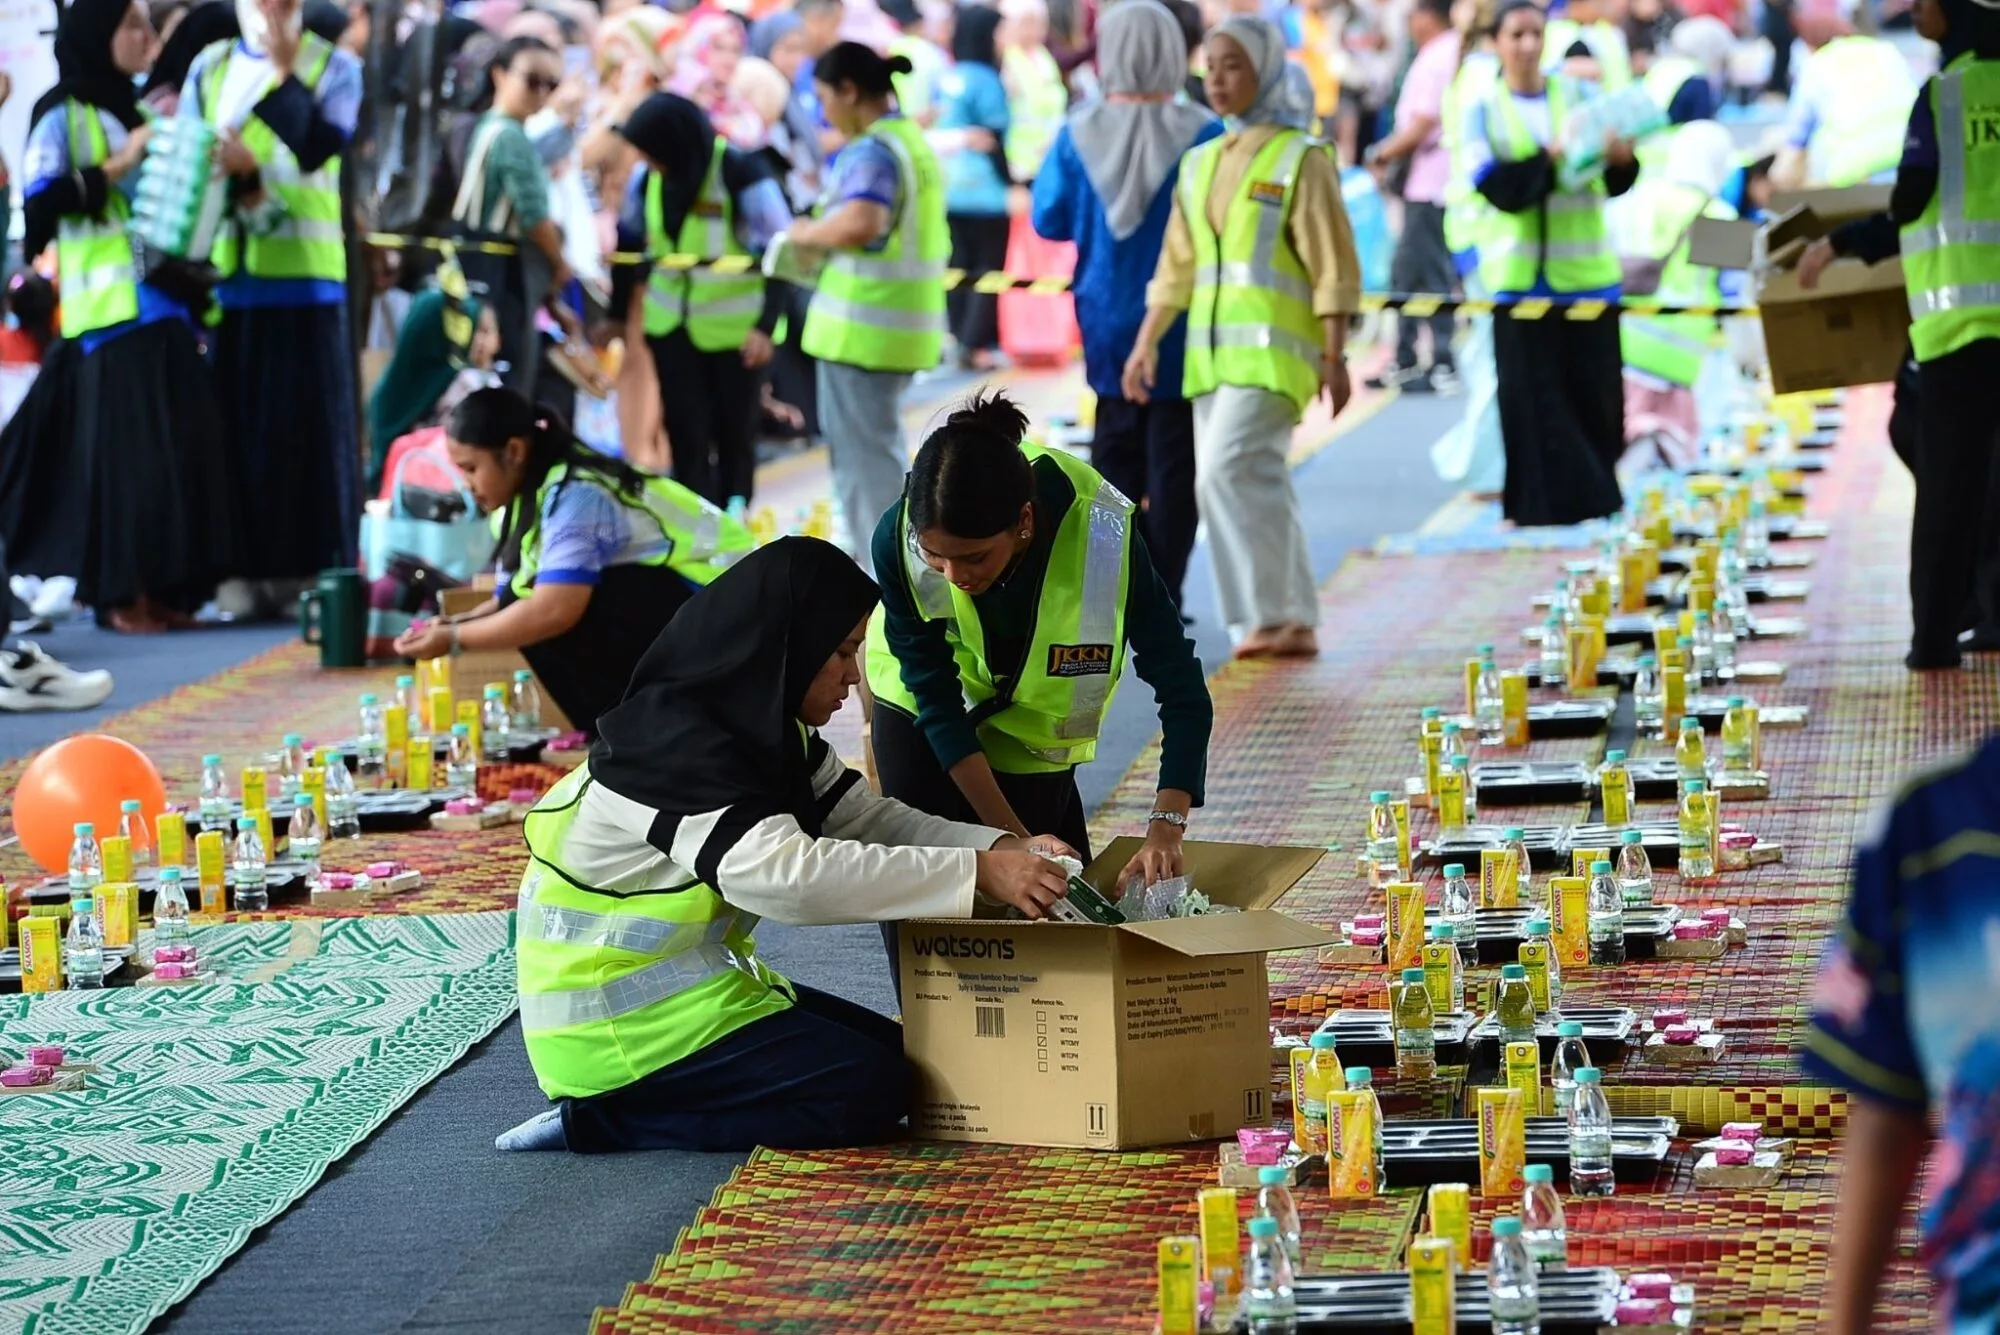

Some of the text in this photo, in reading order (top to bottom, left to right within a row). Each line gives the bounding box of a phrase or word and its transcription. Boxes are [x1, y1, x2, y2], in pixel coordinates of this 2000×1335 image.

[1050, 646, 1111, 673] JKKN
[912, 935, 1015, 959] watsons
[914, 969, 935, 977] Product
[980, 973, 1002, 982] Bamboo
[1003, 974, 1018, 982] Travel
[1019, 974, 1038, 983] Tissues
